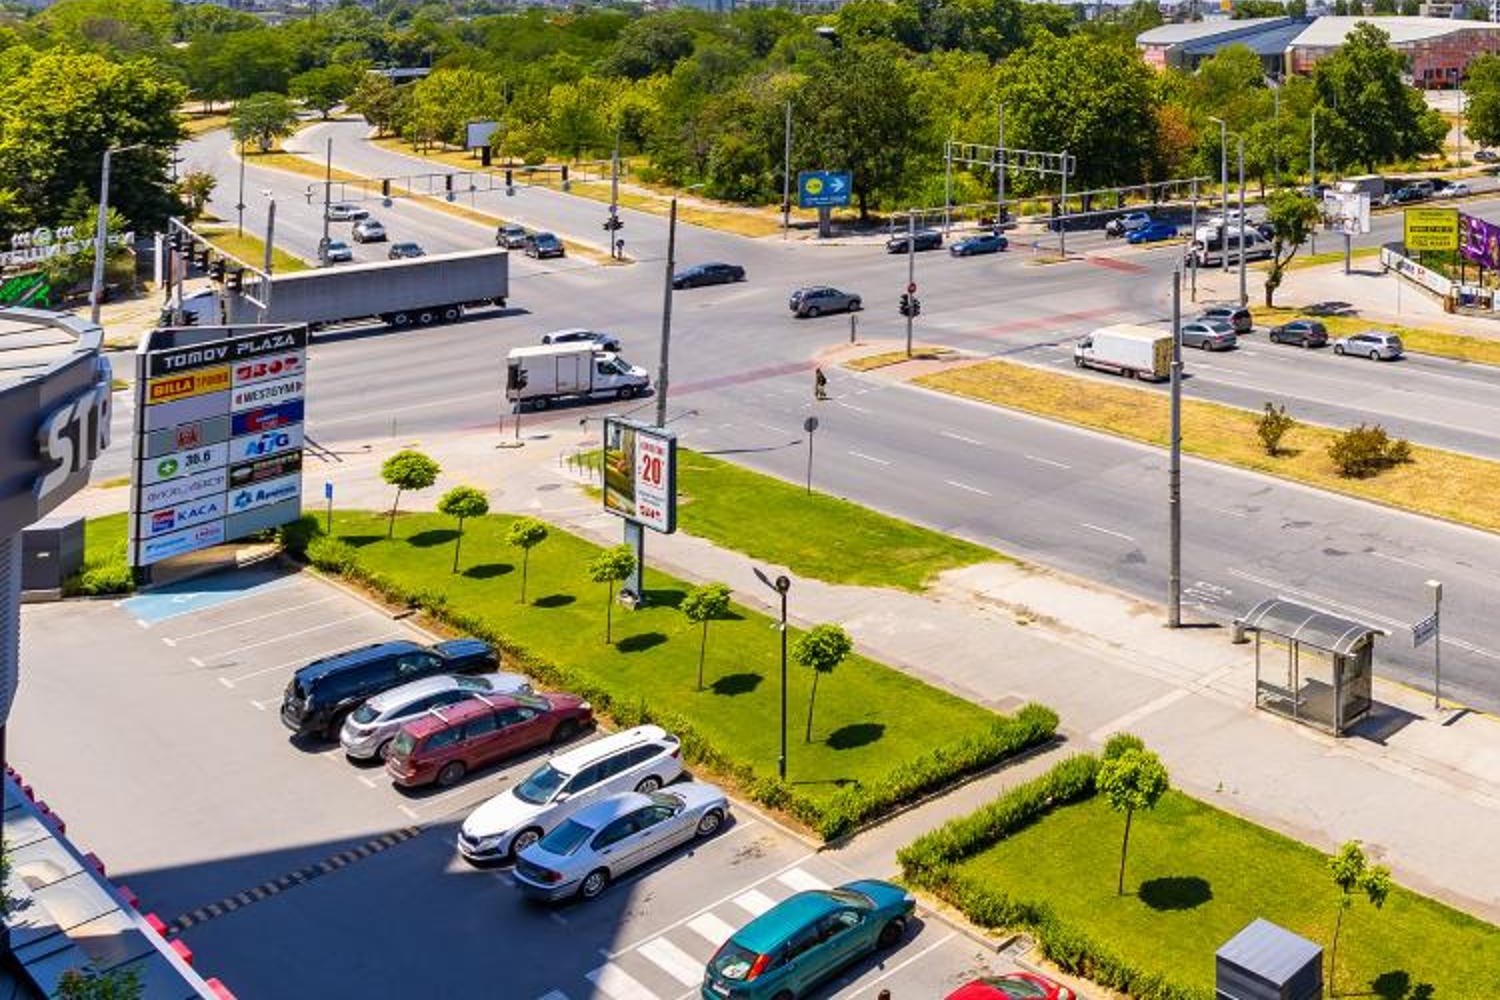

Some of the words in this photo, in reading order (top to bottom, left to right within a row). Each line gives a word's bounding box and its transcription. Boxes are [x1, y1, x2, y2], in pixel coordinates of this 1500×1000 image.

[164, 346, 228, 368] TOMOV
[237, 335, 295, 354] PLAZA
[153, 378, 192, 397] BILLA
[643, 454, 661, 484] 20
